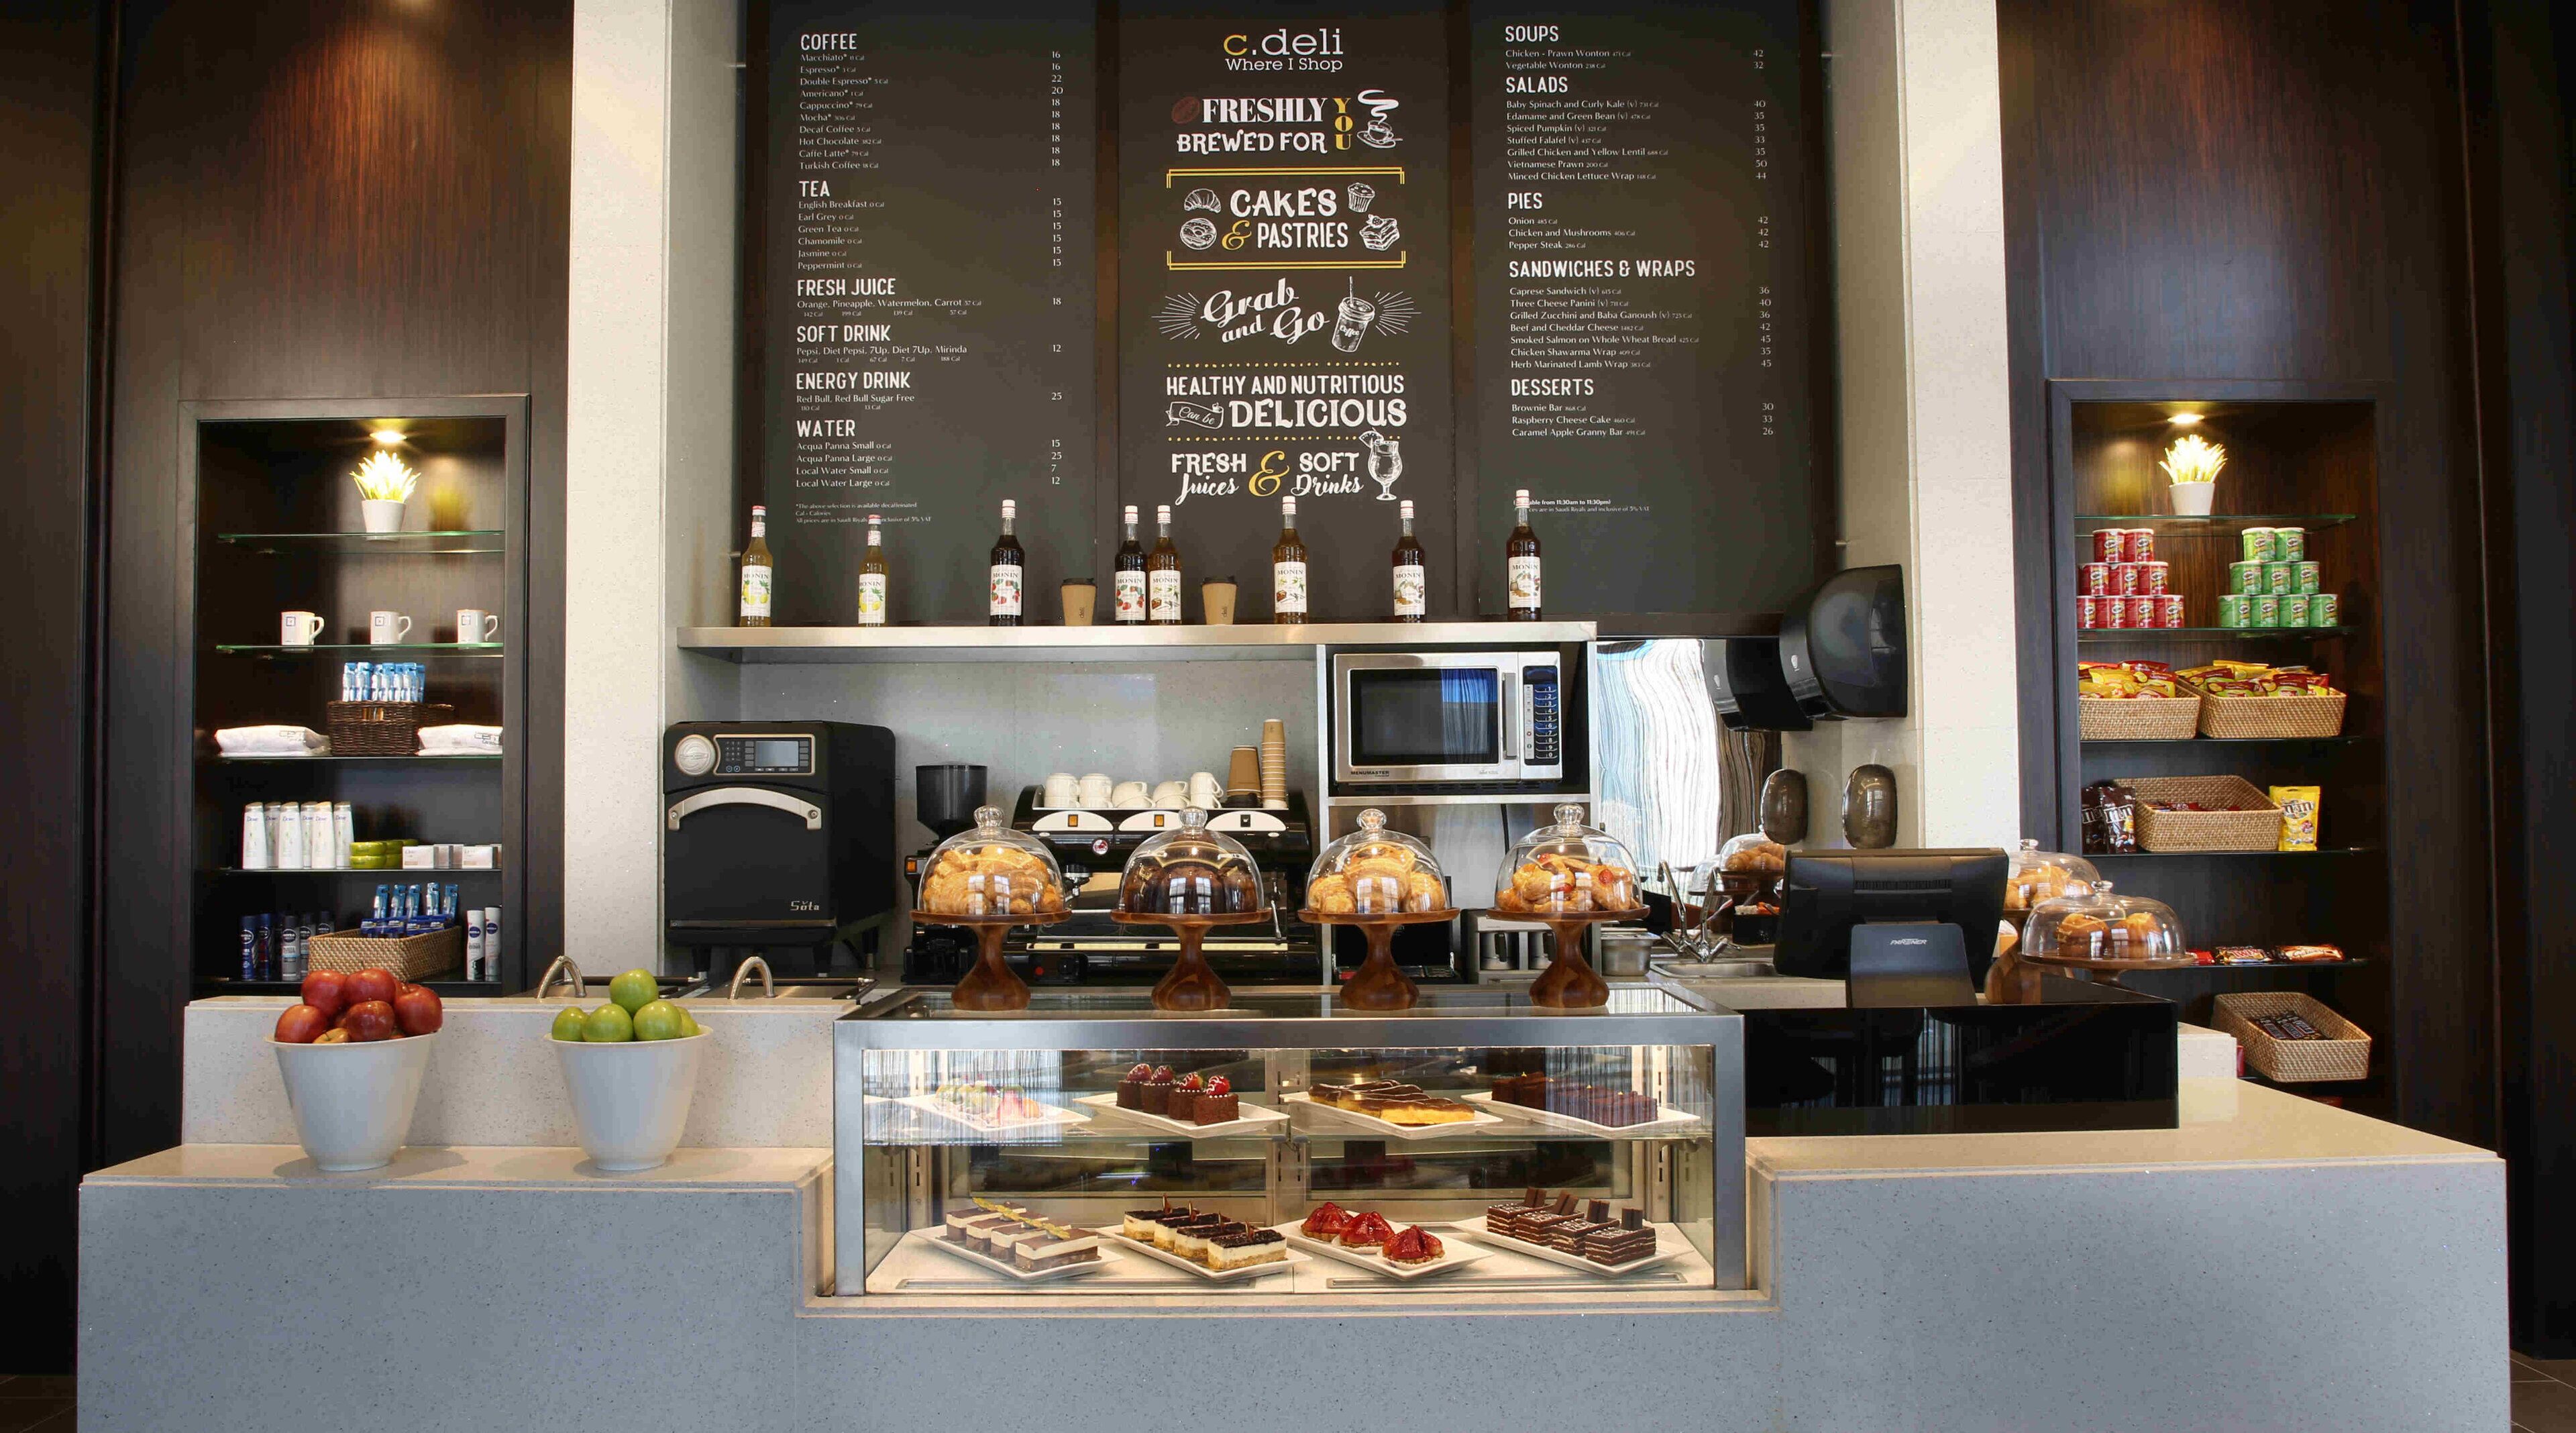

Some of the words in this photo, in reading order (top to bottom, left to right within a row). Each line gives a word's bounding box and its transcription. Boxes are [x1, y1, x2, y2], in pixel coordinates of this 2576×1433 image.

[801, 34, 857, 50] COFFEE
[1224, 28, 1343, 56] c.deli
[1505, 25, 1558, 42] SOUPS
[1226, 58, 1282, 71] Where
[1288, 59, 1293, 70] I
[1299, 59, 1343, 72] Shop
[1506, 61, 1546, 70] Vegetable
[800, 77, 830, 85] Double
[1506, 76, 1568, 93] SALADS
[1202, 97, 1328, 123] FRESHLY
[1507, 124, 1534, 133] Spiced
[1538, 124, 1572, 133] Pumpkin
[1177, 129, 1274, 154] BREWED
[1280, 131, 1327, 153] FOR
[799, 180, 830, 197] TEA
[799, 201, 826, 210] English
[830, 200, 867, 208] Breakfast
[1230, 188, 1338, 217] CAKES
[1508, 193, 1542, 209] PIES
[799, 213, 814, 221] Earl
[816, 213, 837, 221] Grey
[1222, 220, 1252, 251] &
[1257, 221, 1348, 248] PASTRIES
[1509, 242, 1538, 250] Pepper
[798, 262, 844, 270] Peppermint
[1509, 260, 1613, 277] SANDWICHES
[1619, 260, 1630, 276] &
[1636, 260, 1695, 276] WRAPS
[798, 279, 845, 296] FRESH
[851, 278, 896, 295] JUICE
[1510, 288, 1544, 297] Caprese
[1201, 278, 1299, 327] Grab
[797, 325, 838, 342] SOFT
[844, 325, 890, 341] DRINK
[1222, 315, 1265, 343] and
[1270, 306, 1329, 345] Go
[1340, 325, 1360, 337] Coffee
[796, 372, 858, 389] ENERGY
[863, 372, 910, 388] DRINK
[1167, 376, 1246, 396] HEALTHY
[1251, 375, 1287, 394] AND
[1291, 374, 1404, 394] NUTRITIOUS
[1511, 378, 1593, 396] DESSERTS
[871, 394, 894, 403] Sugar
[1179, 407, 1200, 420] Can
[1203, 414, 1214, 425] be
[1228, 398, 1407, 427] DELICIOUS
[1513, 416, 1554, 425] Raspberry
[797, 419, 855, 437] WATER
[798, 443, 822, 451] Acqua
[1172, 452, 1246, 475] FRESH
[1248, 450, 1290, 496] &
[1299, 452, 1359, 472] SOFT
[797, 479, 818, 487] Local
[850, 479, 872, 488] Large
[1175, 473, 1239, 506] Juices
[1291, 474, 1364, 496] Drinks
